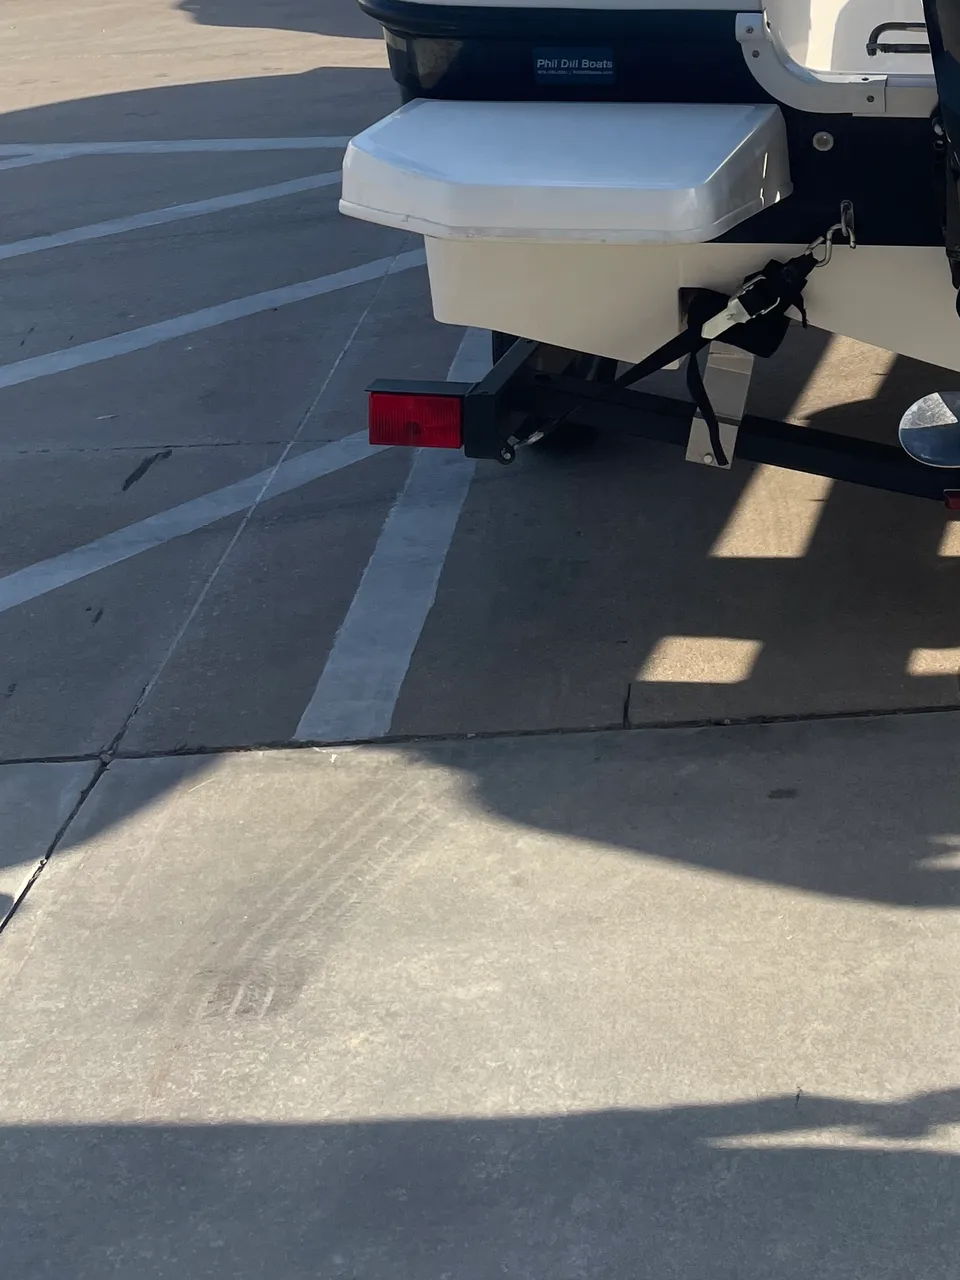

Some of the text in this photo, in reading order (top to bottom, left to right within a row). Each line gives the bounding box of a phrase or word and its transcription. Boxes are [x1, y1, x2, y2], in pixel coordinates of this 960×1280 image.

[536, 58, 613, 69] Phil Dill Boats
